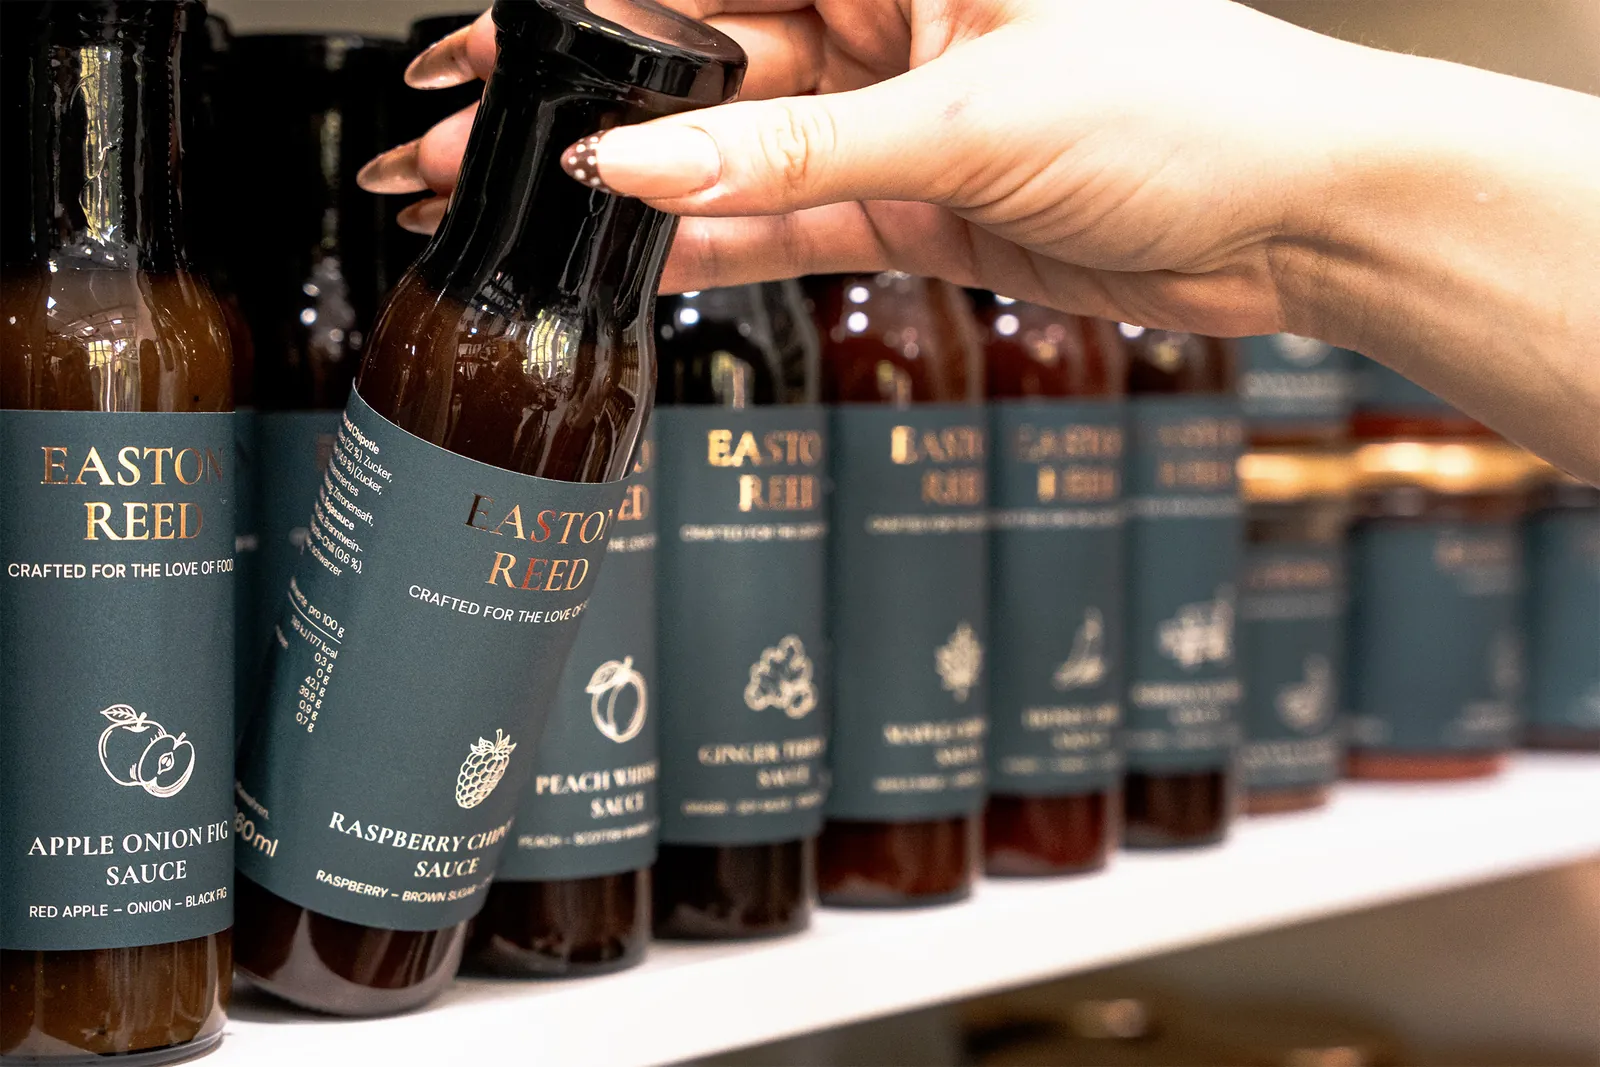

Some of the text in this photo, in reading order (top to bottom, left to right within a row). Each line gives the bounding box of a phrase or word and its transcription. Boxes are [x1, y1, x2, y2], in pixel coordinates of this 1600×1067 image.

[352, 425, 380, 455] Chipotle
[706, 428, 823, 468] EASTO
[40, 445, 224, 488] EASTON
[353, 466, 382, 496] (Zucker,
[363, 455, 393, 483] Zucker,
[83, 501, 204, 541] REED
[333, 486, 374, 527] Zitronensaft,
[8, 563, 86, 579] CRAFTED
[91, 563, 126, 579] FOR
[131, 562, 161, 578] THE
[165, 561, 198, 577] LOVE
[201, 560, 215, 575] OF
[484, 550, 589, 592] REED
[408, 584, 480, 616] CRAFTED
[483, 605, 515, 622] FOR
[518, 610, 543, 623] THE
[544, 607, 572, 623] LOVE
[308, 605, 345, 639] pro 100 g
[314, 652, 334, 673] 0,3 g
[321, 641, 339, 660] kcal
[316, 668, 330, 686] 0 g
[315, 699, 322, 709] g
[319, 687, 326, 697] g
[296, 712, 315, 733] 0,7 g
[299, 700, 319, 721] 0,9 g
[535, 770, 611, 795] PEACH
[590, 791, 645, 819] SAUCE
[27, 820, 228, 856] APPLE ONION FIG
[328, 811, 466, 853] RASPBERRY
[106, 859, 188, 887] SAUCE
[413, 856, 480, 878] SAUCE
[315, 869, 389, 899] RASPBERRY
[402, 890, 447, 903] BROWN
[29, 905, 58, 918] RED
[62, 904, 109, 918] APPLE
[127, 899, 172, 915] ONION
[185, 890, 216, 908] BLACK
[215, 886, 227, 900] FIG
